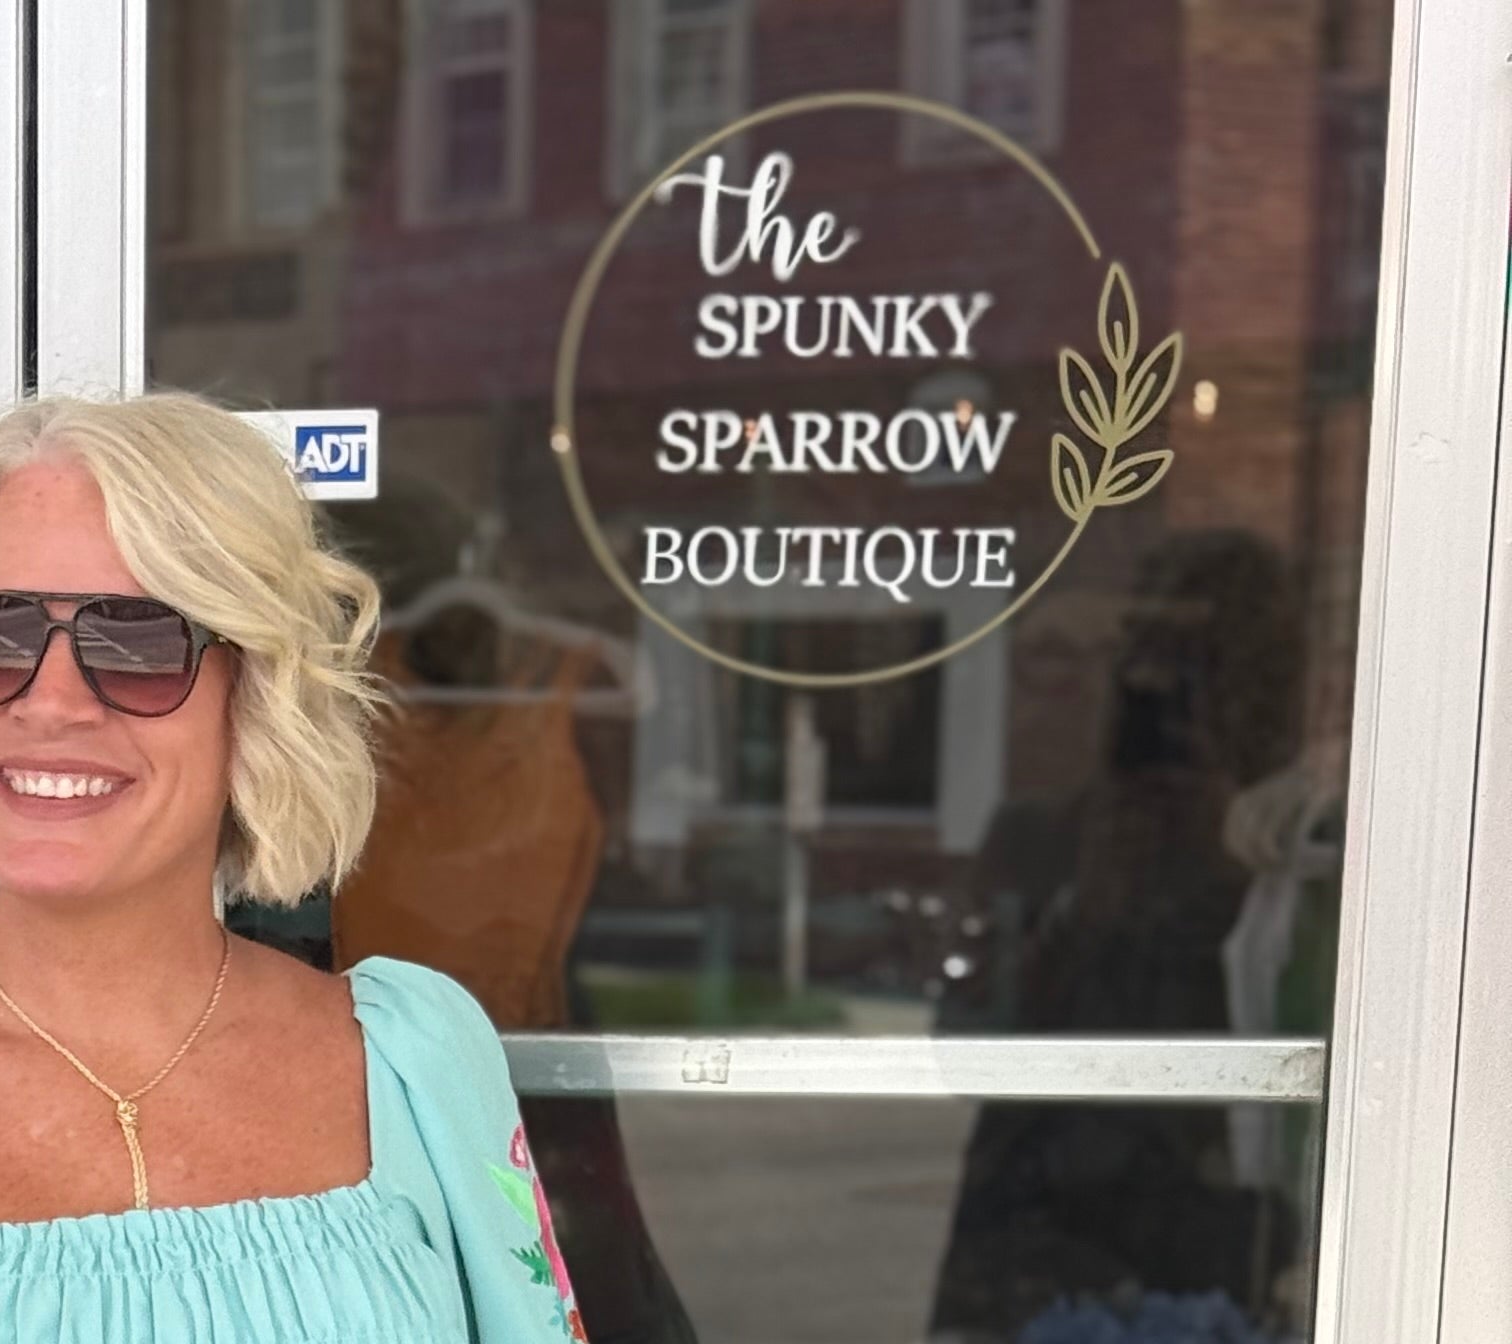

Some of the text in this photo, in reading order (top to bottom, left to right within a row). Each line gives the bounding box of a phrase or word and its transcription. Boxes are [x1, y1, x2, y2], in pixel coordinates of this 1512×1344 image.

[655, 152, 861, 282] the
[694, 292, 994, 359] SPUNKY
[294, 432, 366, 474] ADT
[656, 408, 1017, 475] SPARROW
[641, 526, 1017, 603] BOUTIQUE
